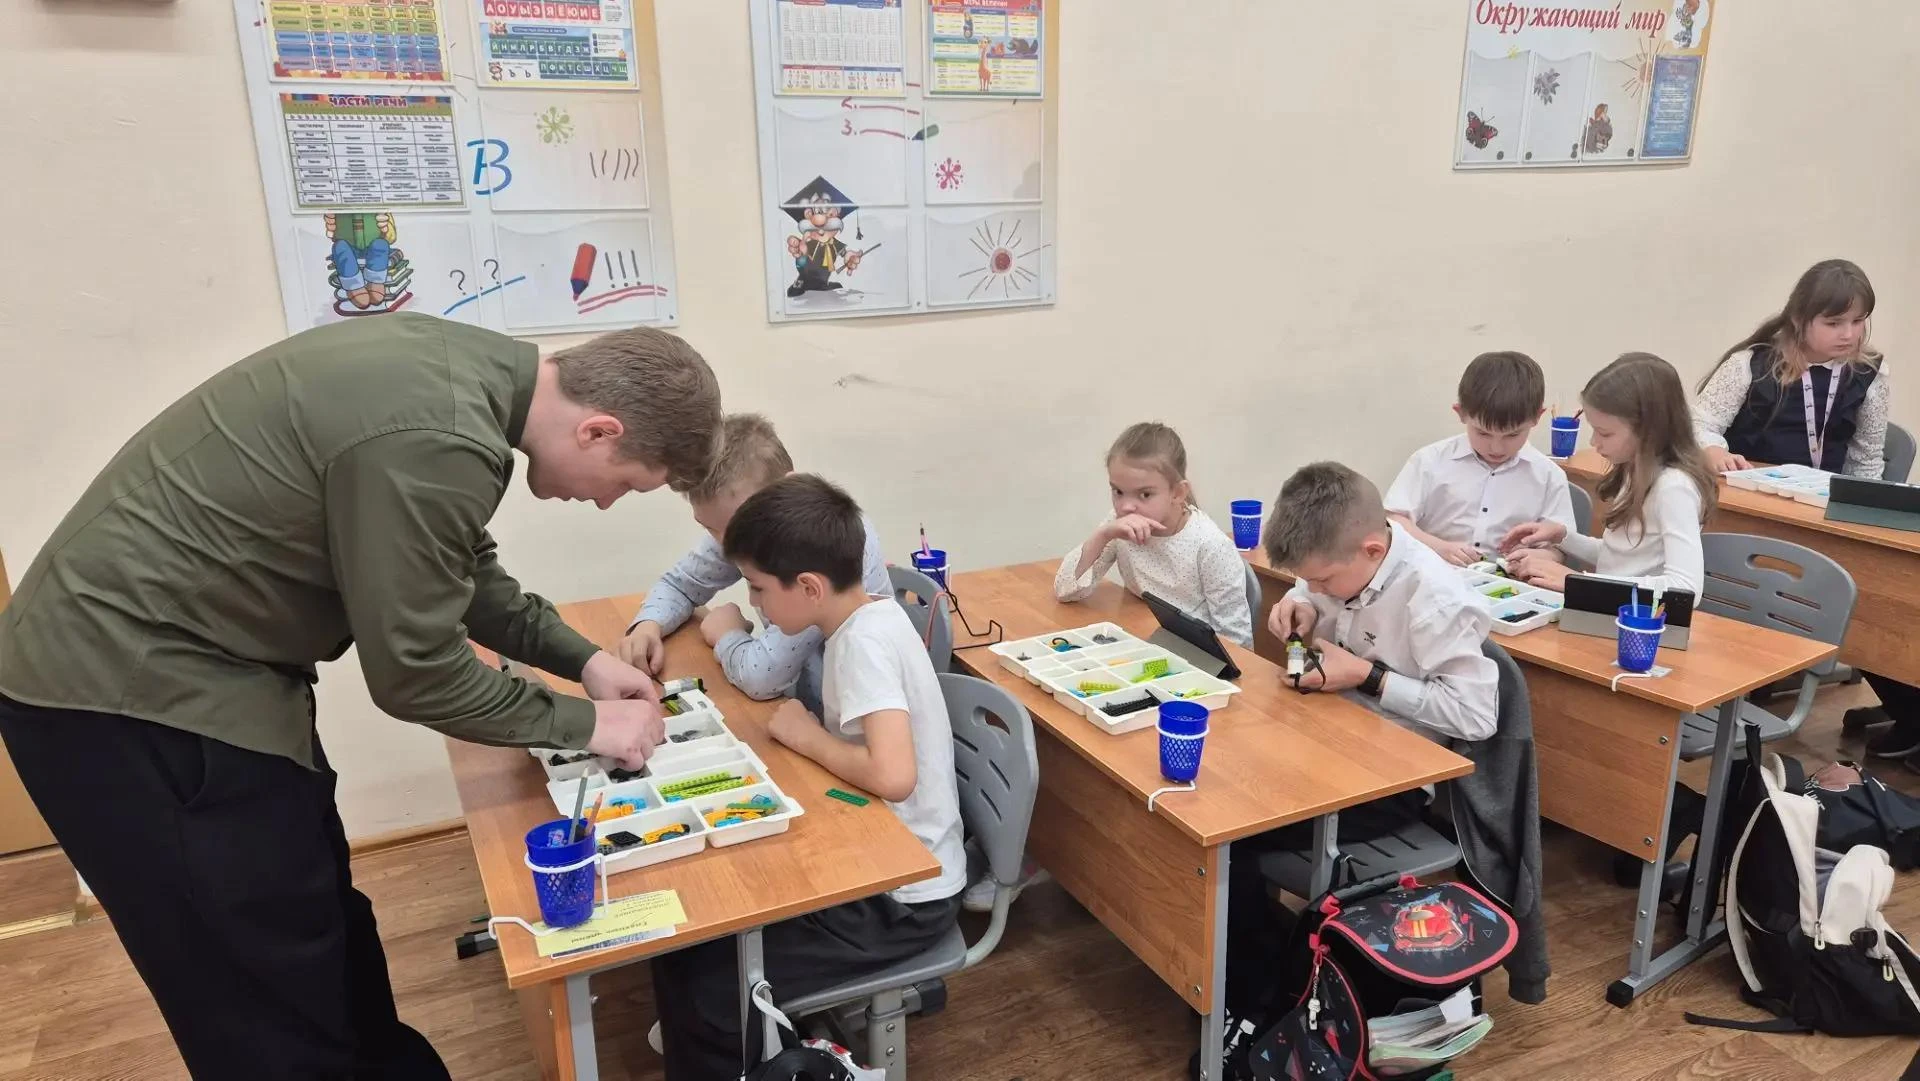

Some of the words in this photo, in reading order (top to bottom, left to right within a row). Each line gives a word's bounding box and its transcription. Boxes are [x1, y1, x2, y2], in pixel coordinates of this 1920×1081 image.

[1476, 0, 1621, 34] Окружающий
[1625, 9, 1666, 38] мир
[328, 96, 371, 107] ЧАСТИ
[374, 97, 408, 107] РЕЧИ
